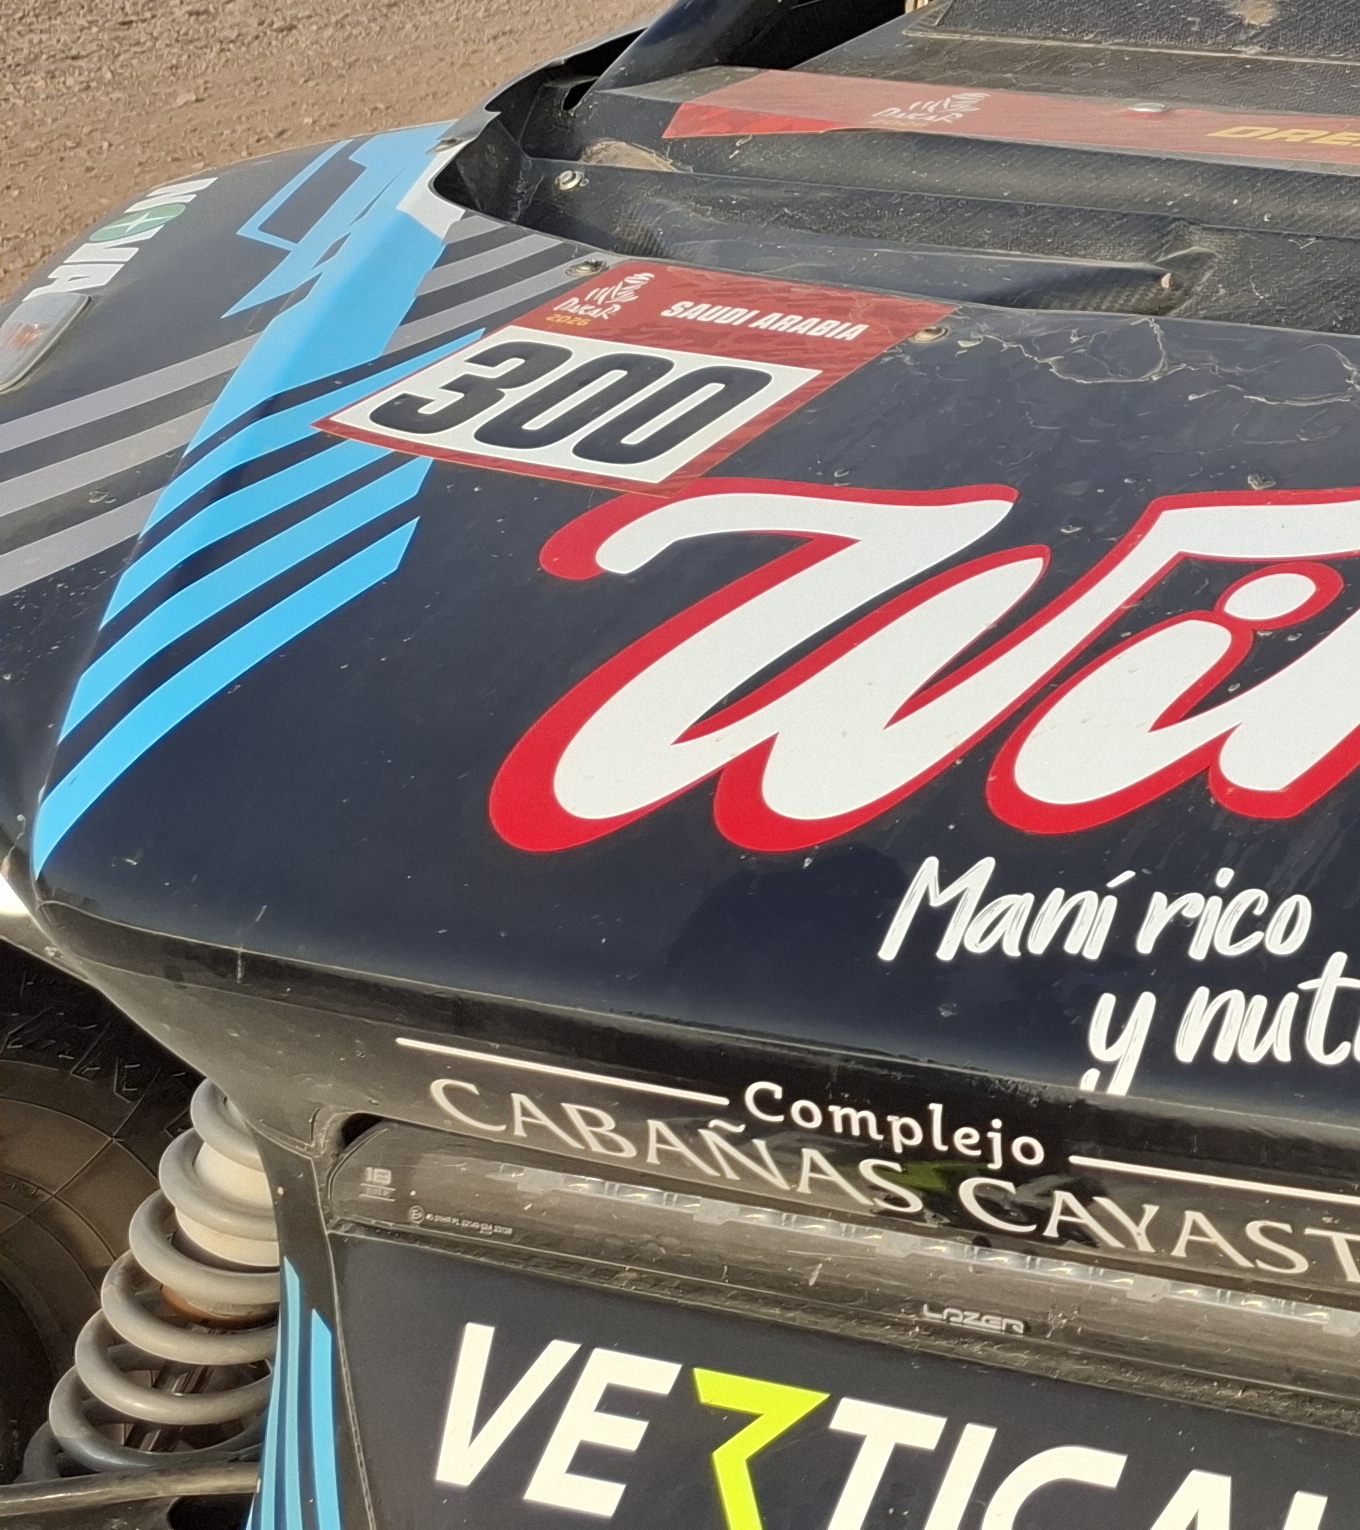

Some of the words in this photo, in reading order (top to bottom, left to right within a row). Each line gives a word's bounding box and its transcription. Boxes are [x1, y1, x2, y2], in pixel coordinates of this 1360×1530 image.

[545, 313, 591, 326] 2026
[554, 297, 621, 320] DAKAR
[661, 300, 760, 326] SAUDI
[750, 312, 869, 341] ARABIA
[369, 341, 772, 464] 300
[877, 856, 1126, 962] Maní
[1144, 868, 1313, 959] rico
[1079, 989, 1156, 1094] y
[428, 1077, 923, 1215] CABAÑAS
[742, 1081, 1047, 1170] Complejo
[923, 1304, 1024, 1334] LAZER
